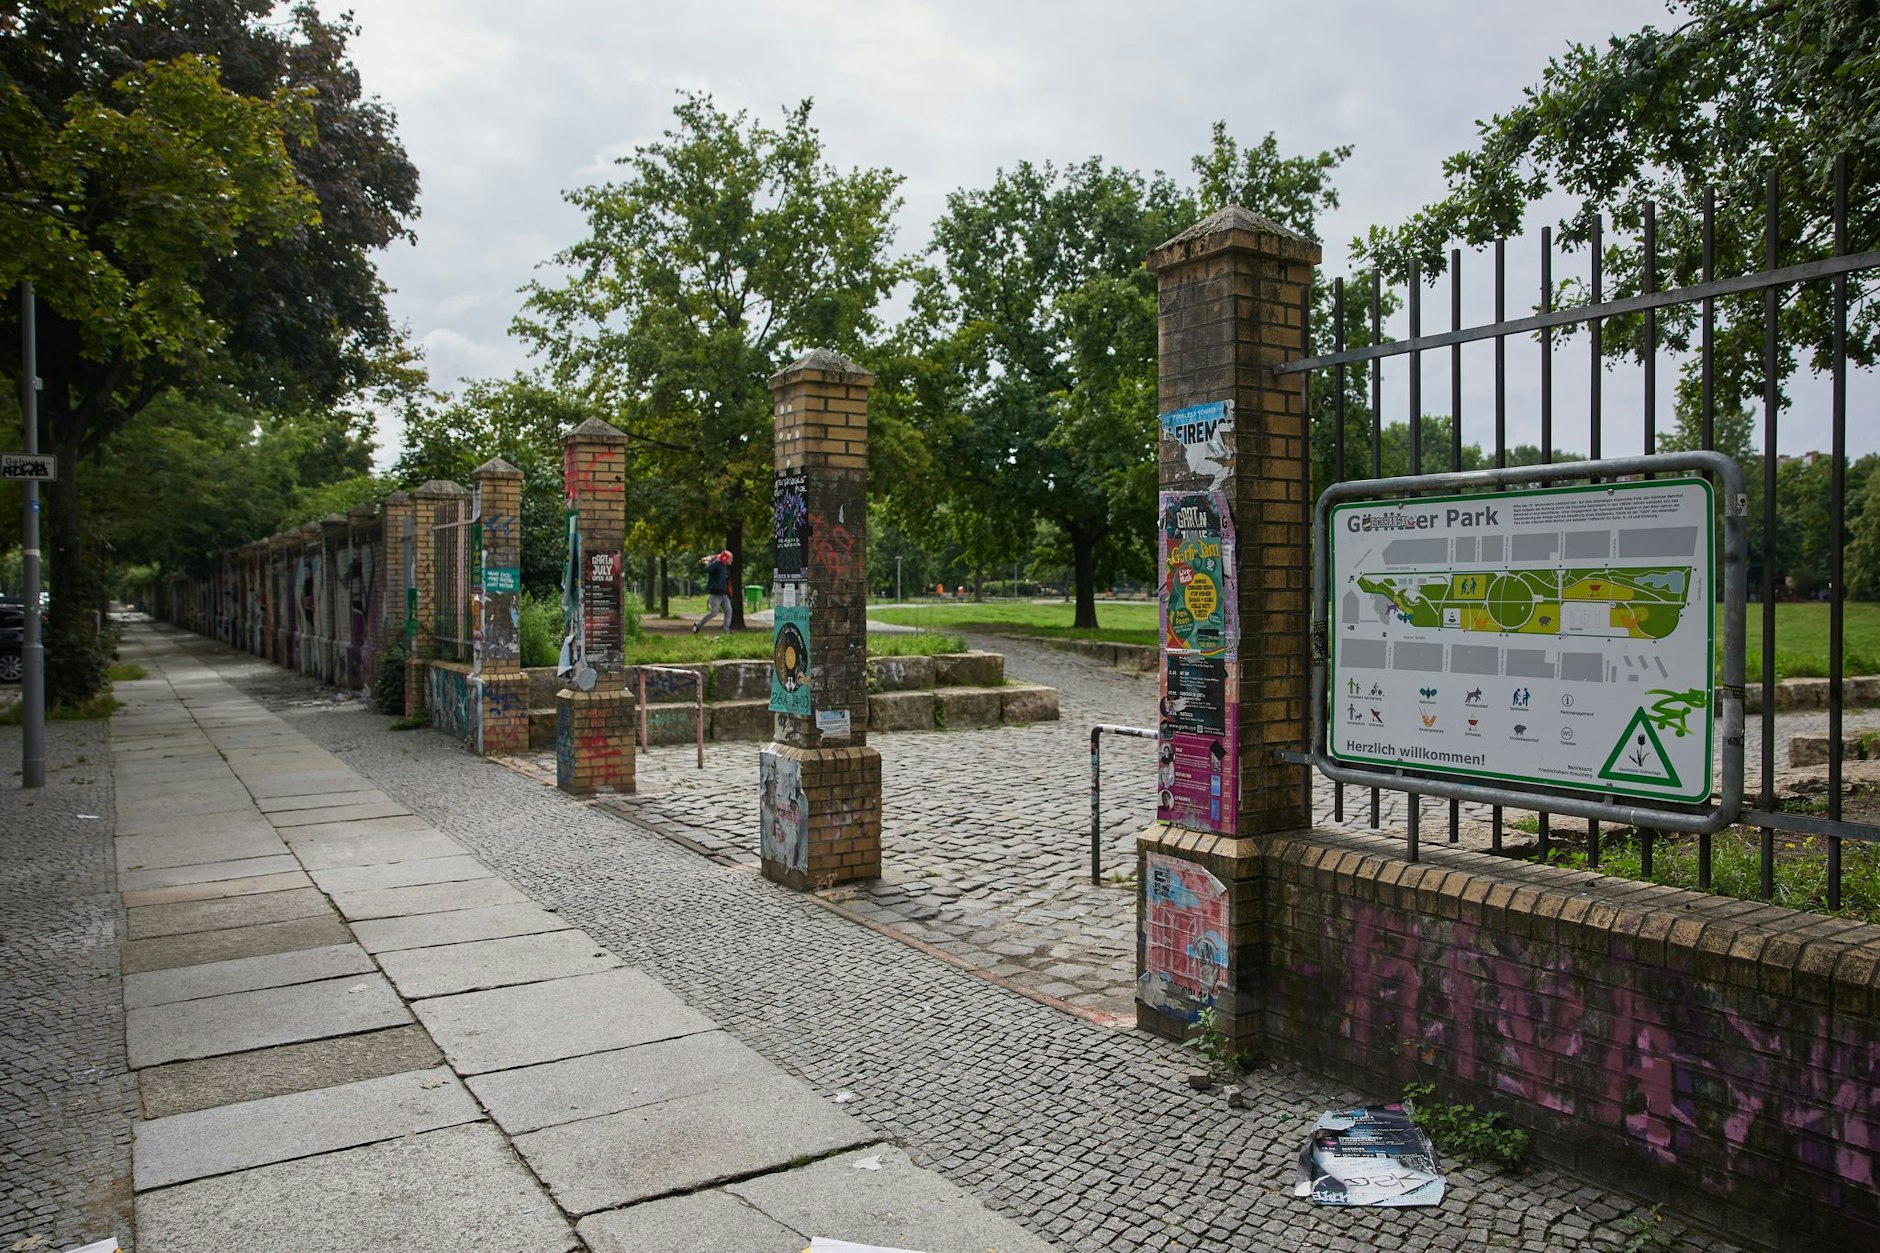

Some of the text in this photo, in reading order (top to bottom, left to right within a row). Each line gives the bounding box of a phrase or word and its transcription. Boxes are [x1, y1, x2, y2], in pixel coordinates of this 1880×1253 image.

[1172, 410, 1196, 420] TIMELESS
[1446, 506, 1499, 528] Park
[592, 565, 613, 576] JULY
[1346, 740, 1486, 766] Herzlich willkommen!
